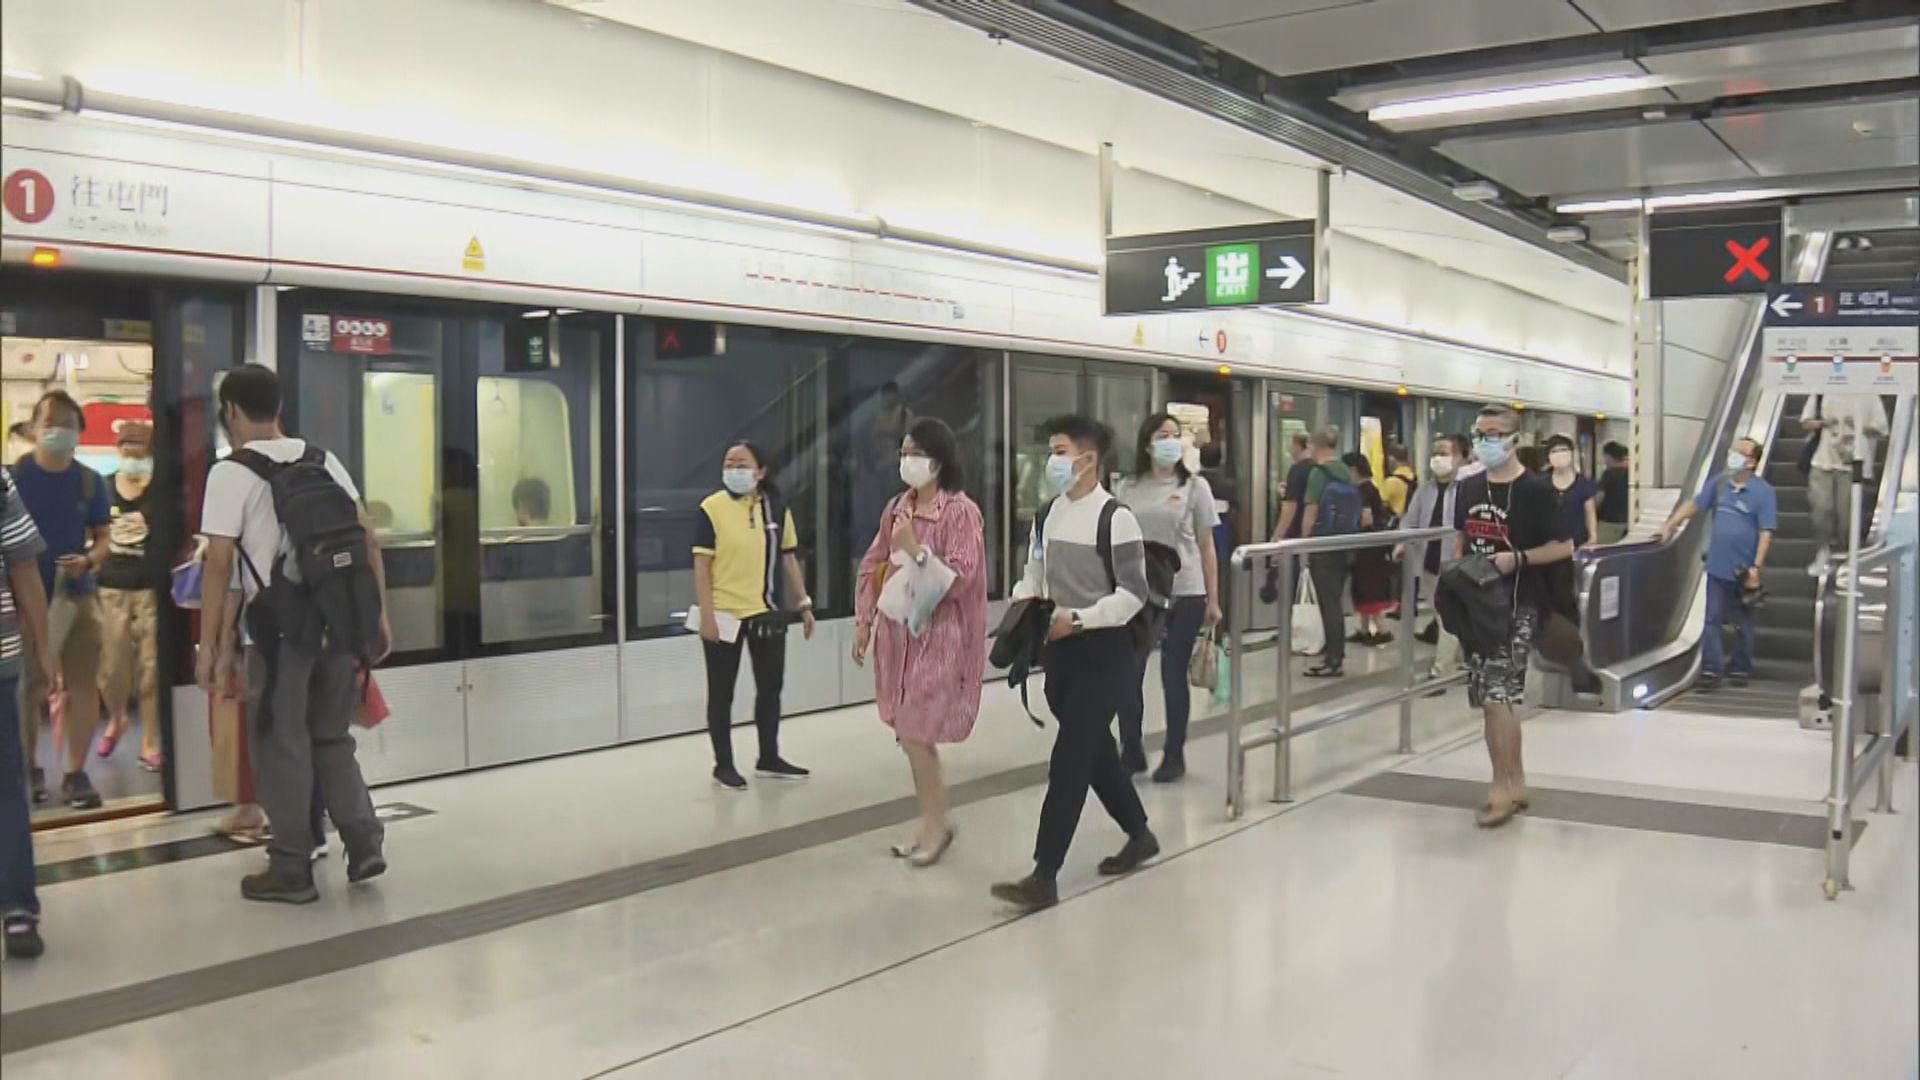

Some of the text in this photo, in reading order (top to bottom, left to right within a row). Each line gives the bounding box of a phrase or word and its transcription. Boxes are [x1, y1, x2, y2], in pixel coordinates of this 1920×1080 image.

[19, 177, 36, 214] 1
[71, 175, 169, 216] 往屯門
[1215, 251, 1249, 284] 出
[1216, 283, 1247, 297] EXIT
[1814, 296, 1825, 313] 1
